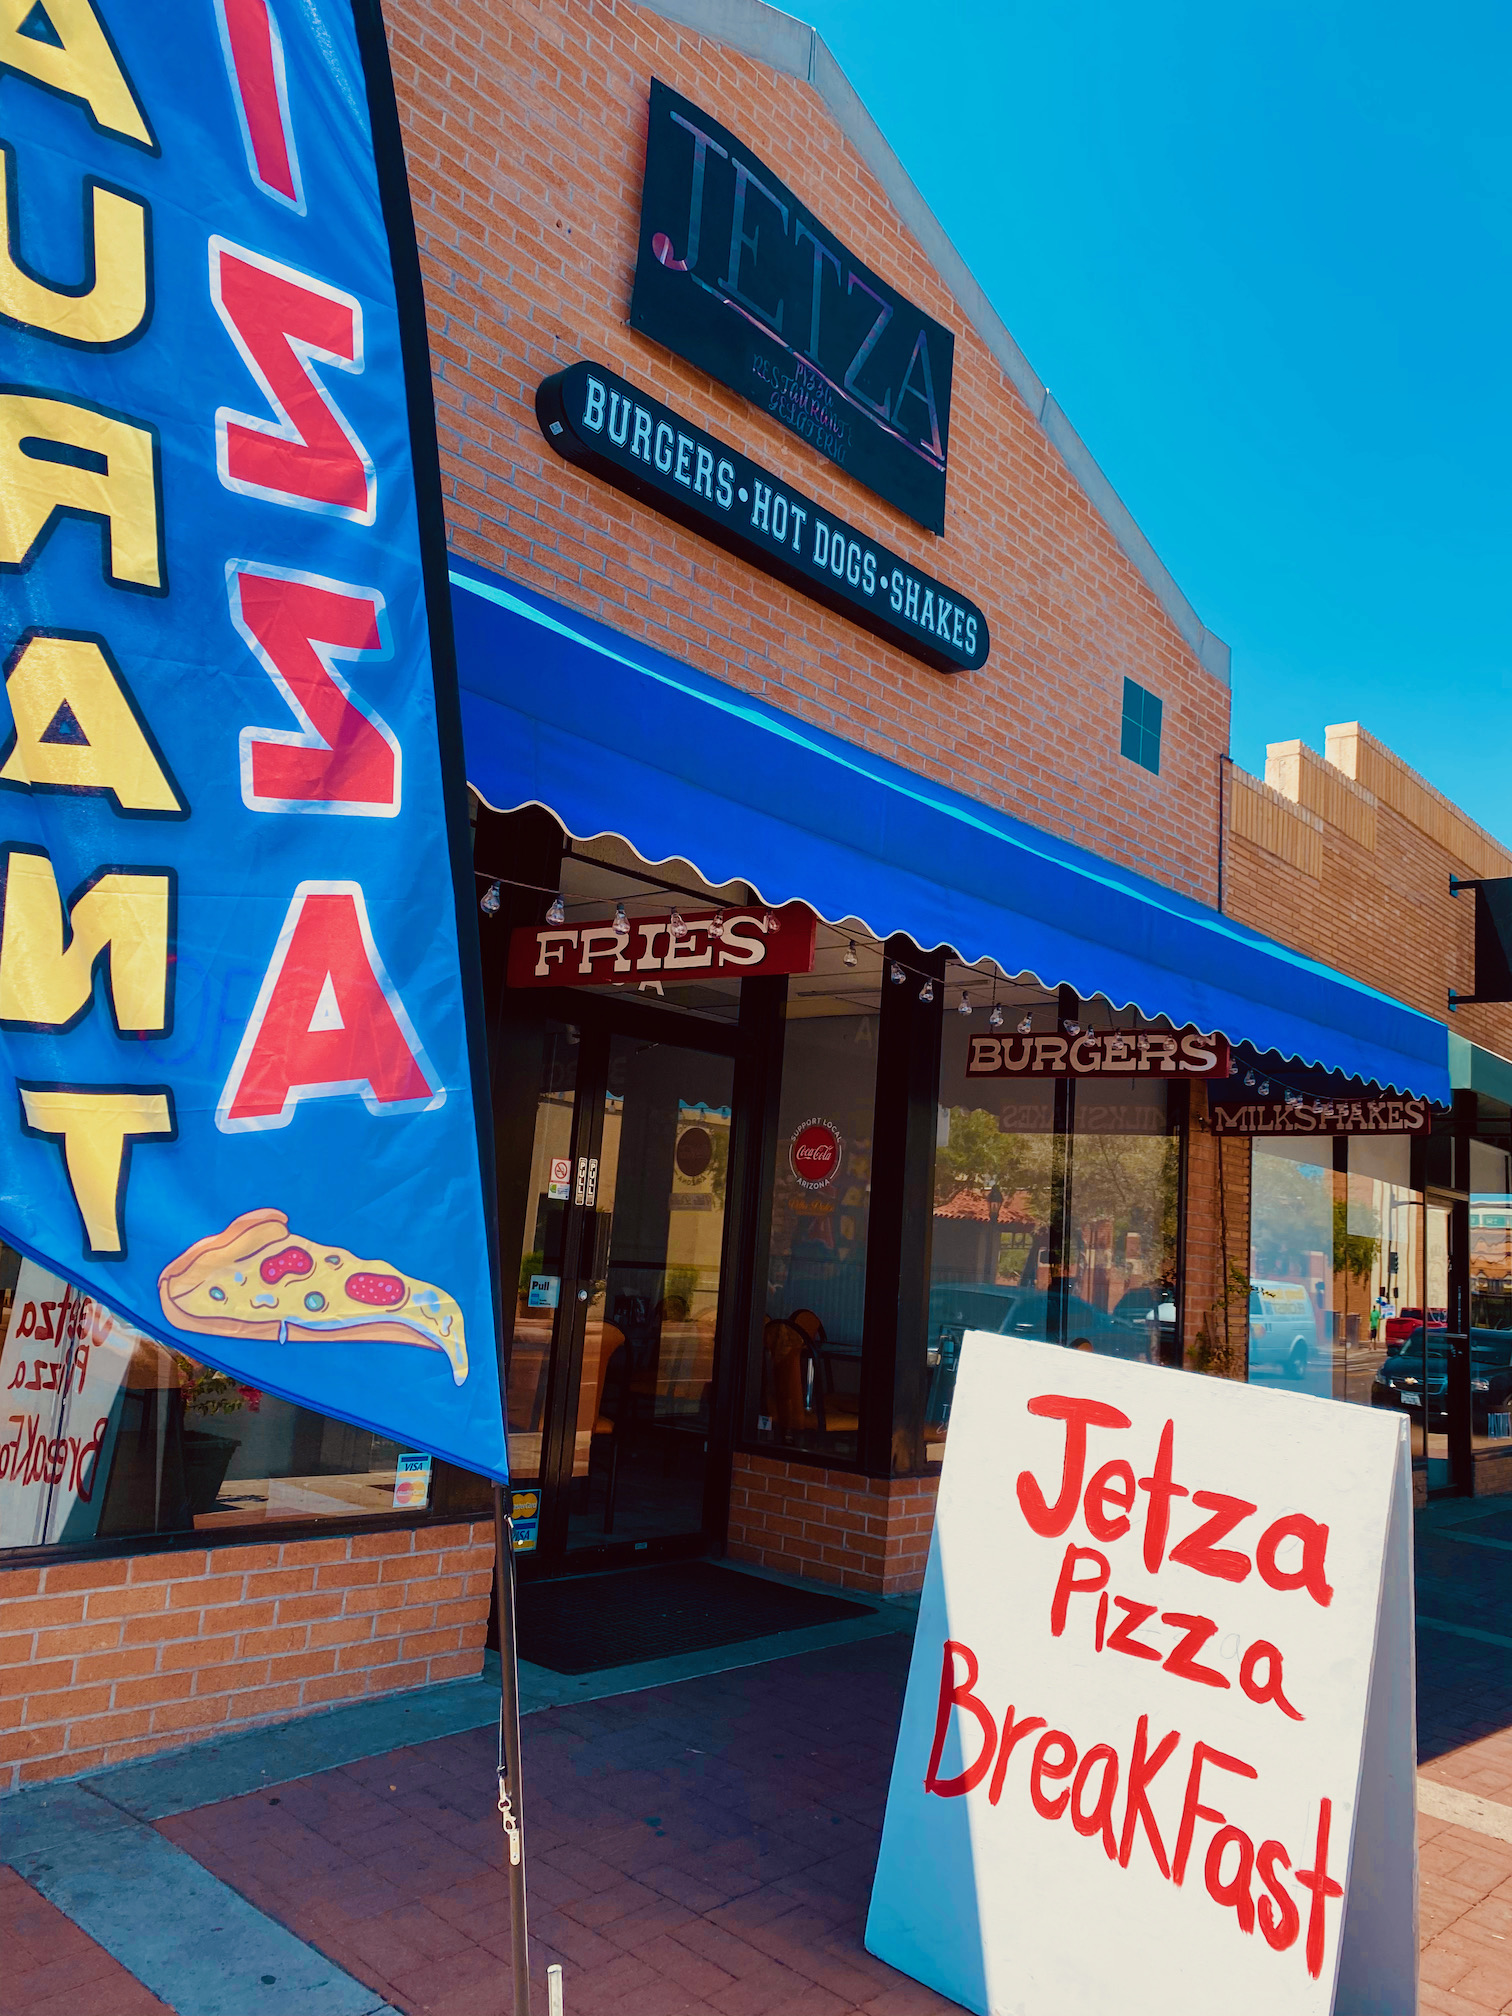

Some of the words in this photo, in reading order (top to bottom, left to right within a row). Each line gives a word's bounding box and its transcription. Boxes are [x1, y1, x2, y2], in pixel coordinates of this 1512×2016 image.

[651, 110, 945, 462] JETZA
[582, 373, 735, 511] BURGERS
[749, 478, 807, 552] HOT
[812, 521, 877, 597] DOGS
[890, 569, 979, 656] SHAKES
[534, 915, 768, 977] FRIES
[969, 1033, 1218, 1073] BURGERS
[791, 1117, 821, 1142] SUPPORT
[823, 1119, 842, 1143] LOCAL
[1214, 1100, 1425, 1131] MILKSHAKES
[577, 1162, 587, 1194] PULL
[587, 1162, 597, 1195] PULL
[796, 1177, 831, 1190] ARIZONA
[531, 1281, 550, 1291] Pull
[405, 1462, 423, 1471] VISA
[1016, 1394, 1333, 1607] Jetza
[1051, 1543, 1306, 1721] Pizza
